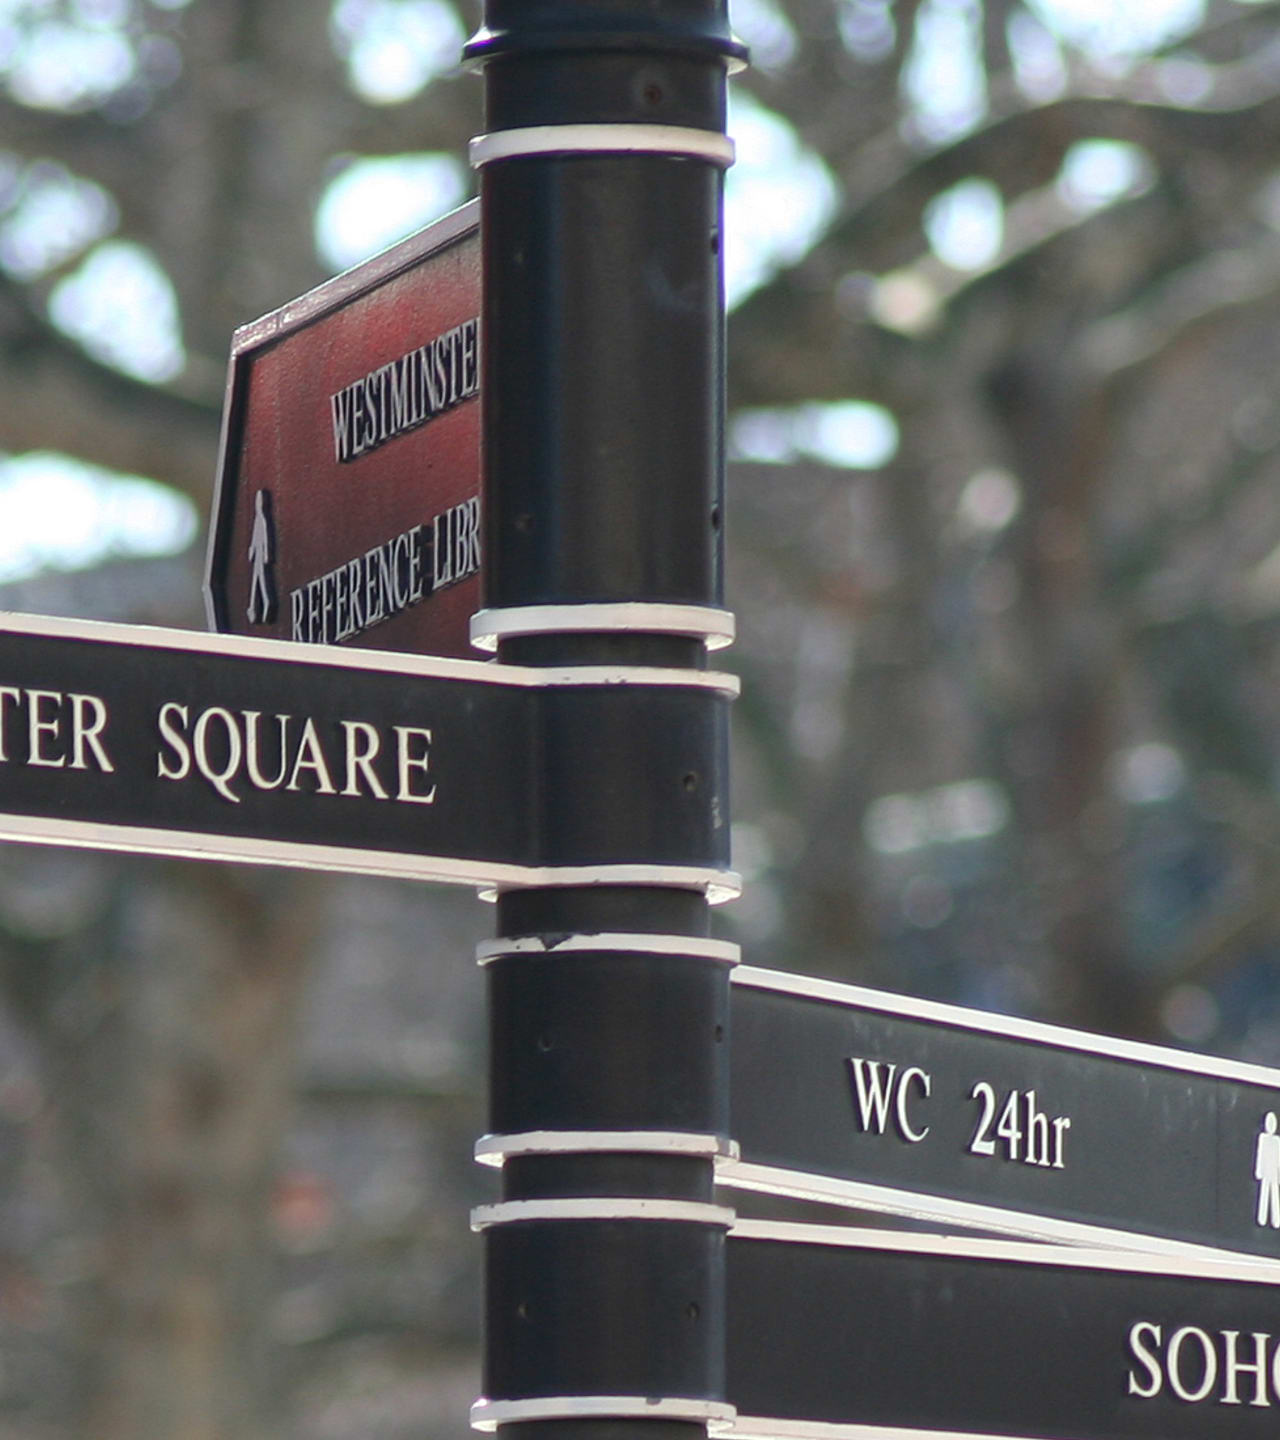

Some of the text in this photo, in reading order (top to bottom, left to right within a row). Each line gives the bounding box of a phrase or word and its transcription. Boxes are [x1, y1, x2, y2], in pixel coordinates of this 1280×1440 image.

[289, 524, 424, 643] REFERENCE
[157, 702, 436, 804] SQUARE
[850, 1057, 1072, 1169] WC 24hr
